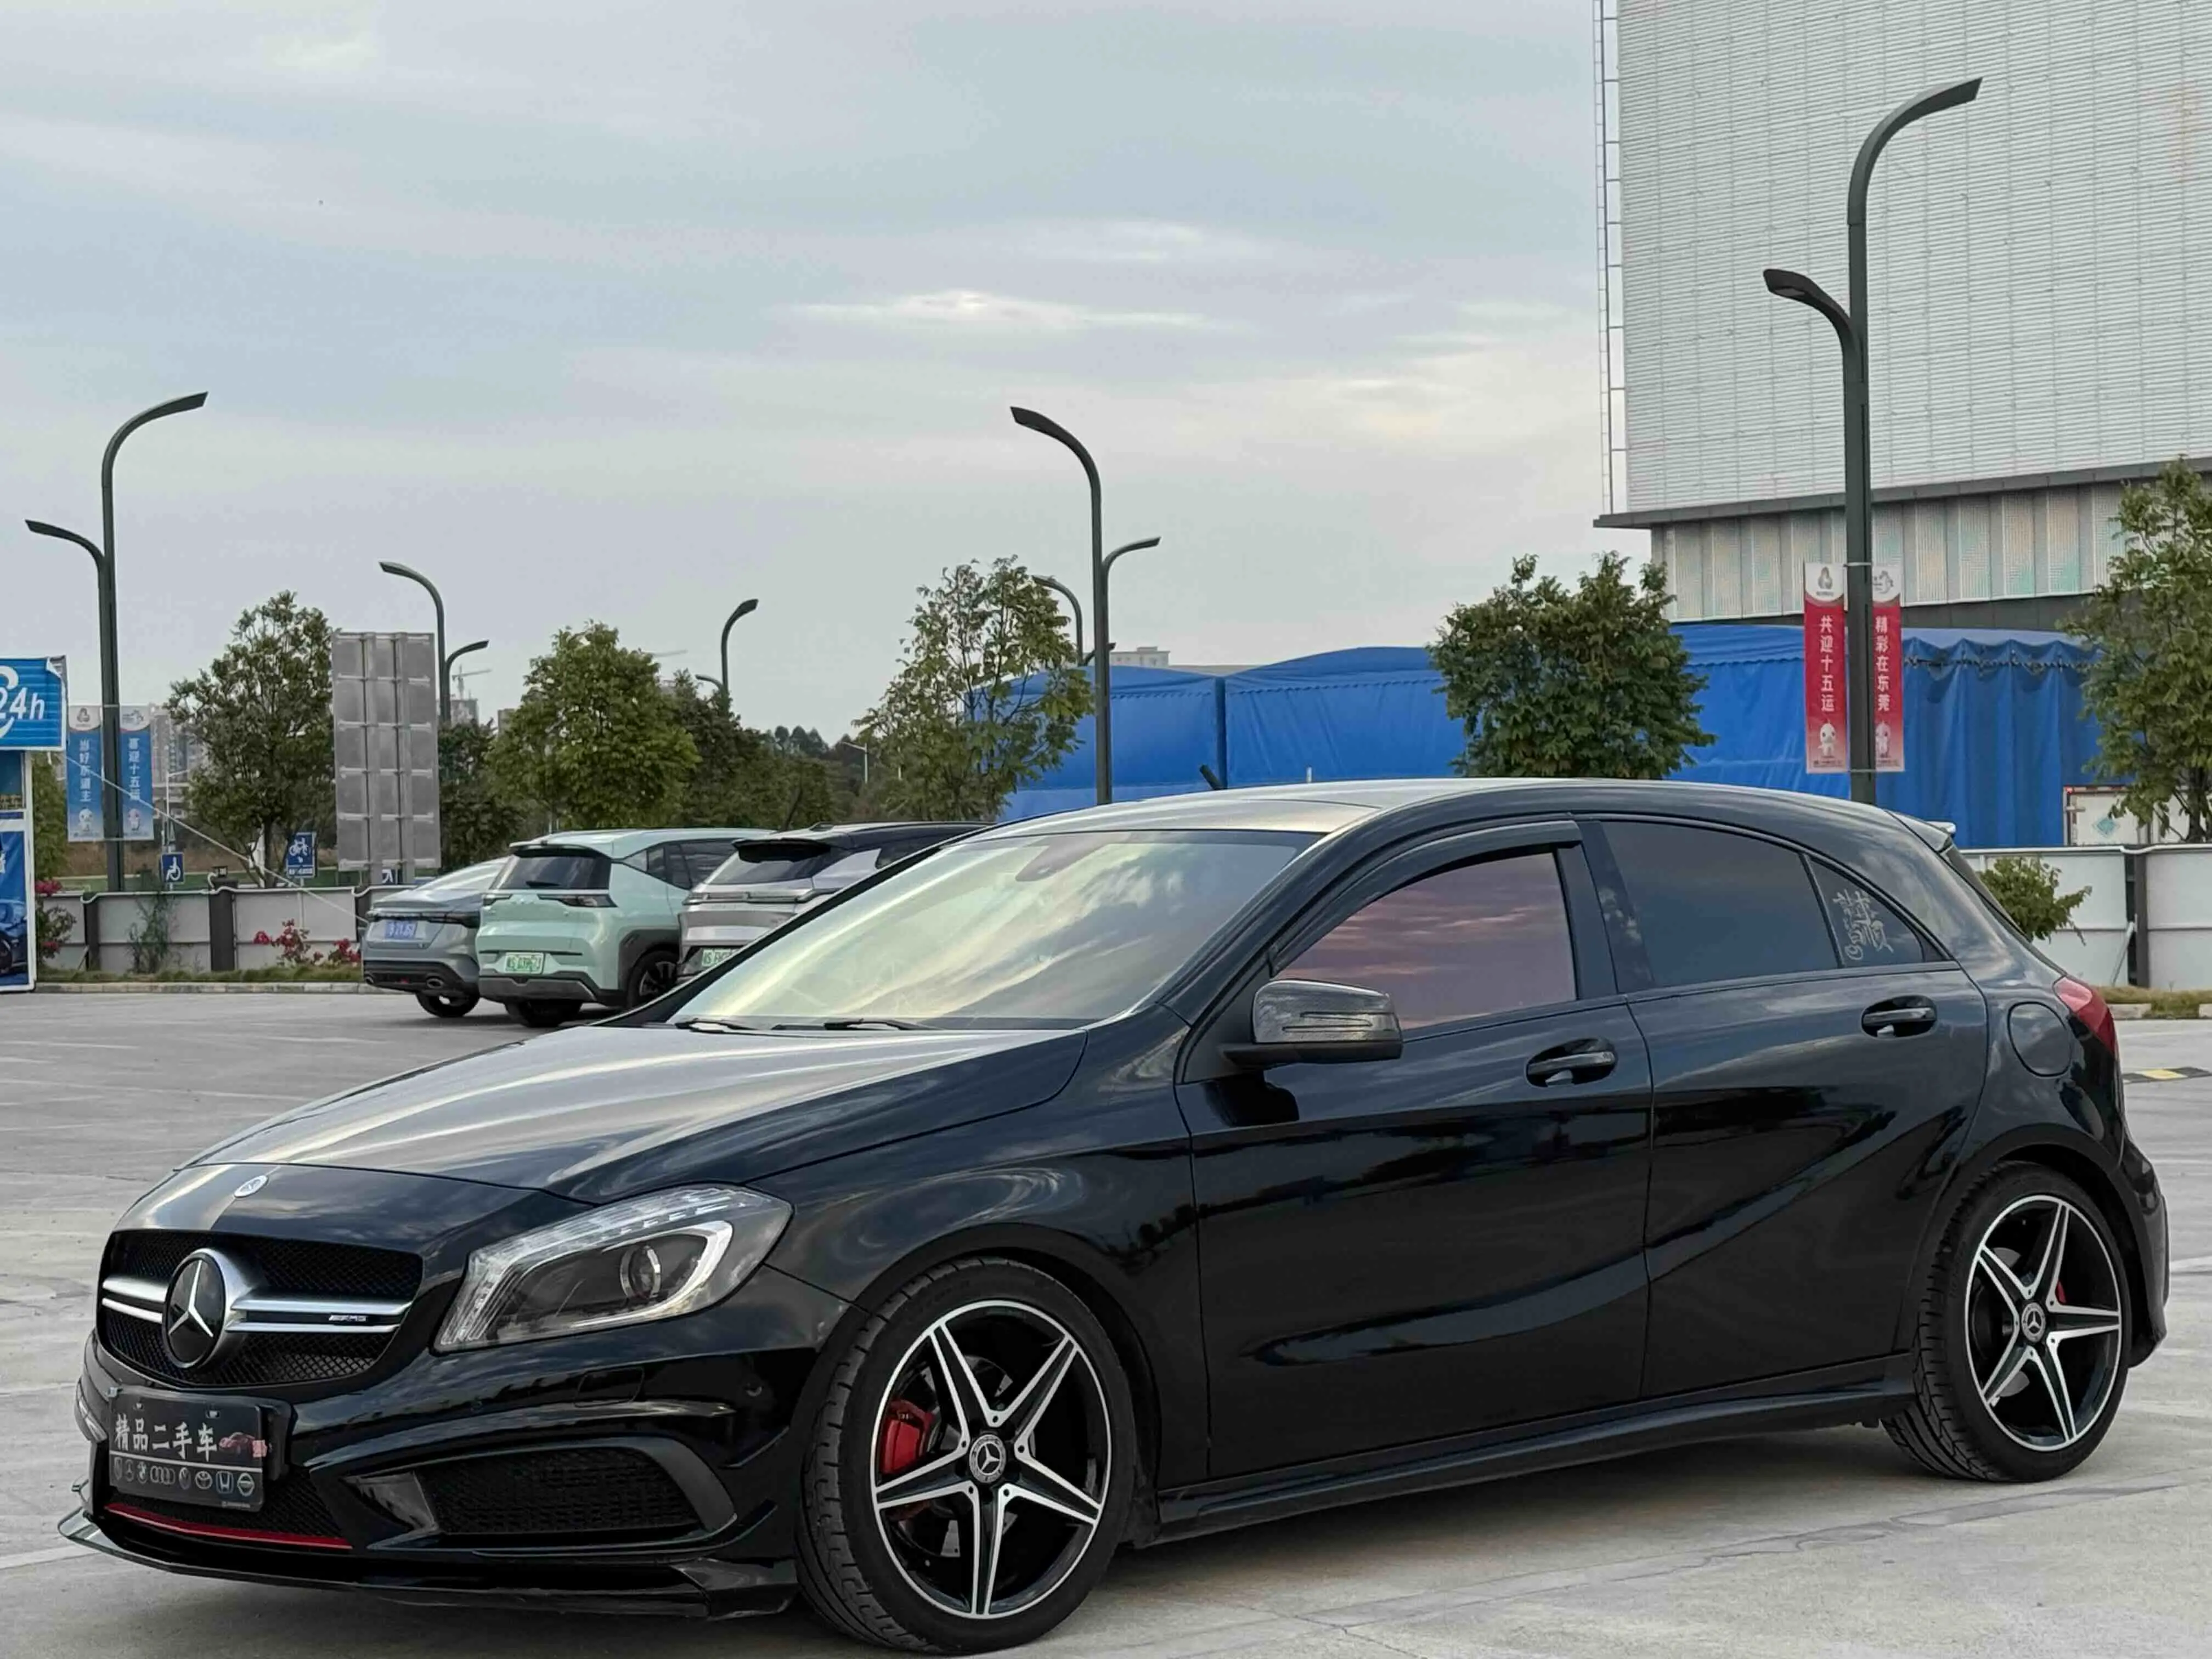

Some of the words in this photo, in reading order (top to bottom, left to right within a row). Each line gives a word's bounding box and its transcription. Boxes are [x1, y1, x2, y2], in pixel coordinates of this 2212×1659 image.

[1819, 615, 1836, 712] 共迎十五运
[1875, 616, 1891, 712] 精彩在东莞
[114, 1413, 217, 1462] 精品二手车
